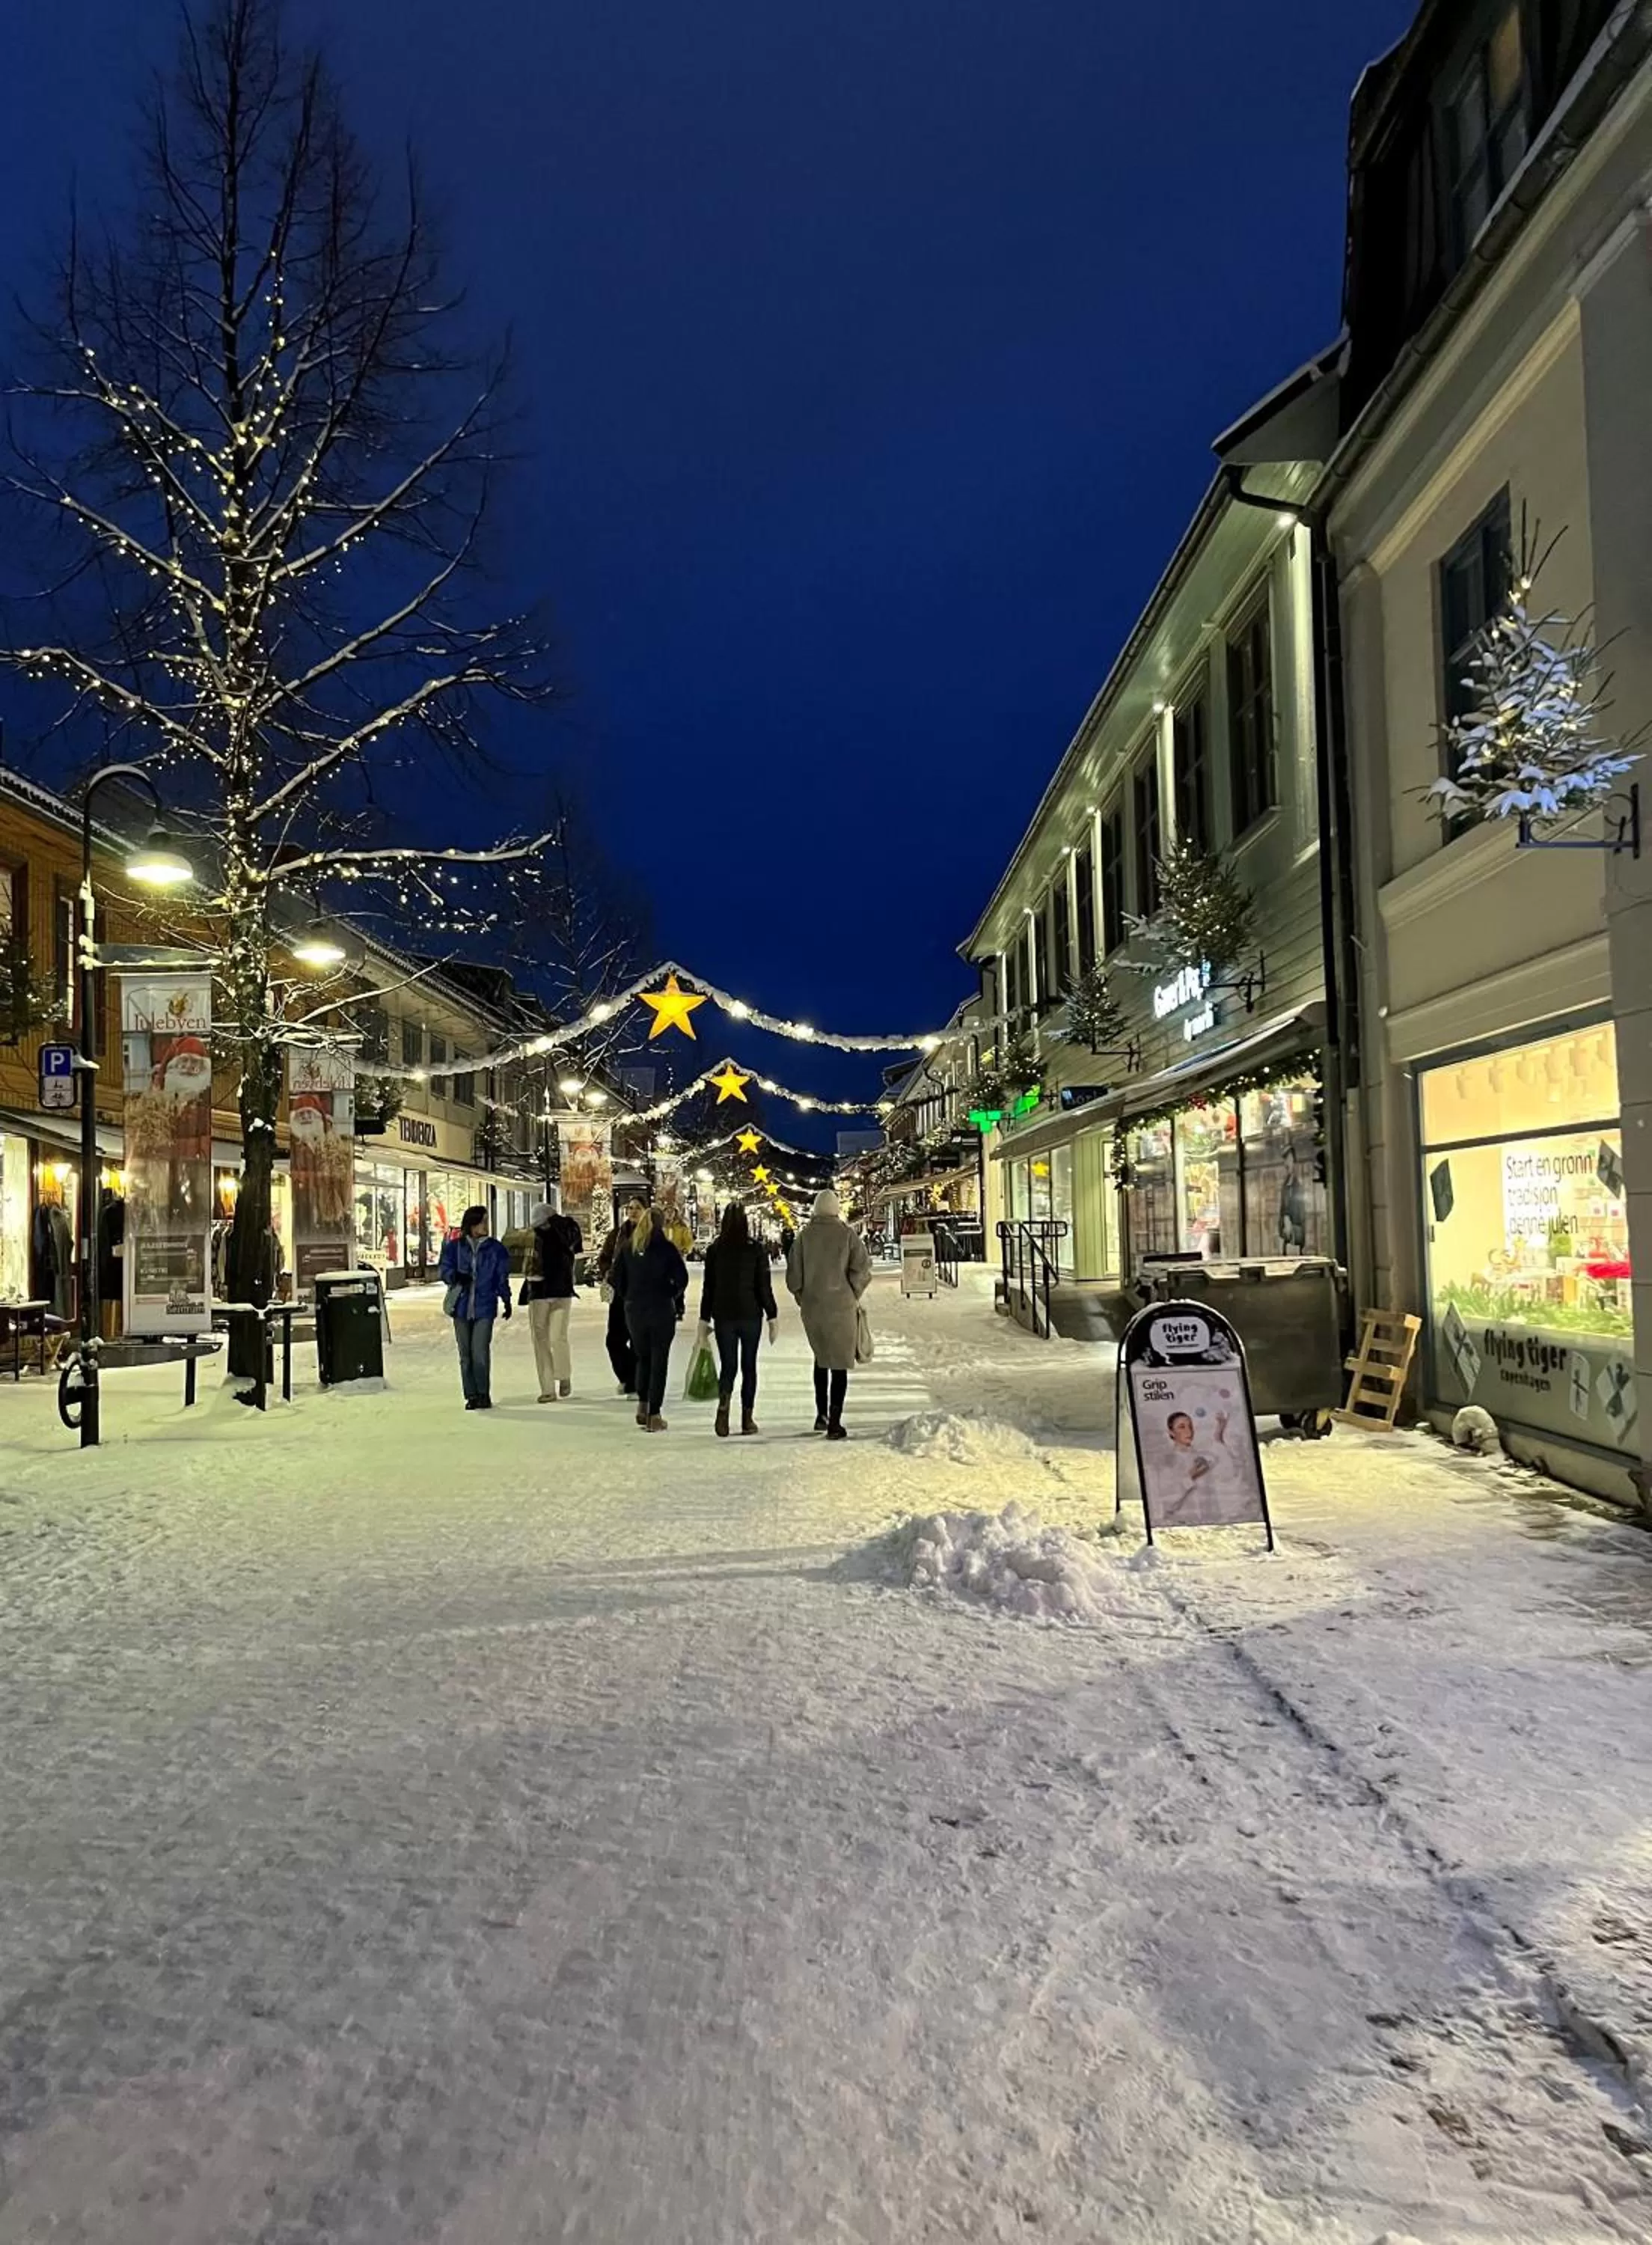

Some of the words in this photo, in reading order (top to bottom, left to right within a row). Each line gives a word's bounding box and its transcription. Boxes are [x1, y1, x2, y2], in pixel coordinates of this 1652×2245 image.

[135, 1011, 207, 1030] Julebyen
[51, 1051, 65, 1073] P
[397, 1115, 437, 1148] TENDENZA
[1506, 1155, 1533, 1180] Start
[1535, 1155, 1551, 1177] en
[1547, 1206, 1579, 1242] julen
[1162, 1322, 1198, 1334] flying
[1166, 1332, 1197, 1343] tiger
[1484, 1328, 1524, 1369] flying
[1526, 1336, 1567, 1374] tiger
[1142, 1378, 1167, 1390] Grip
